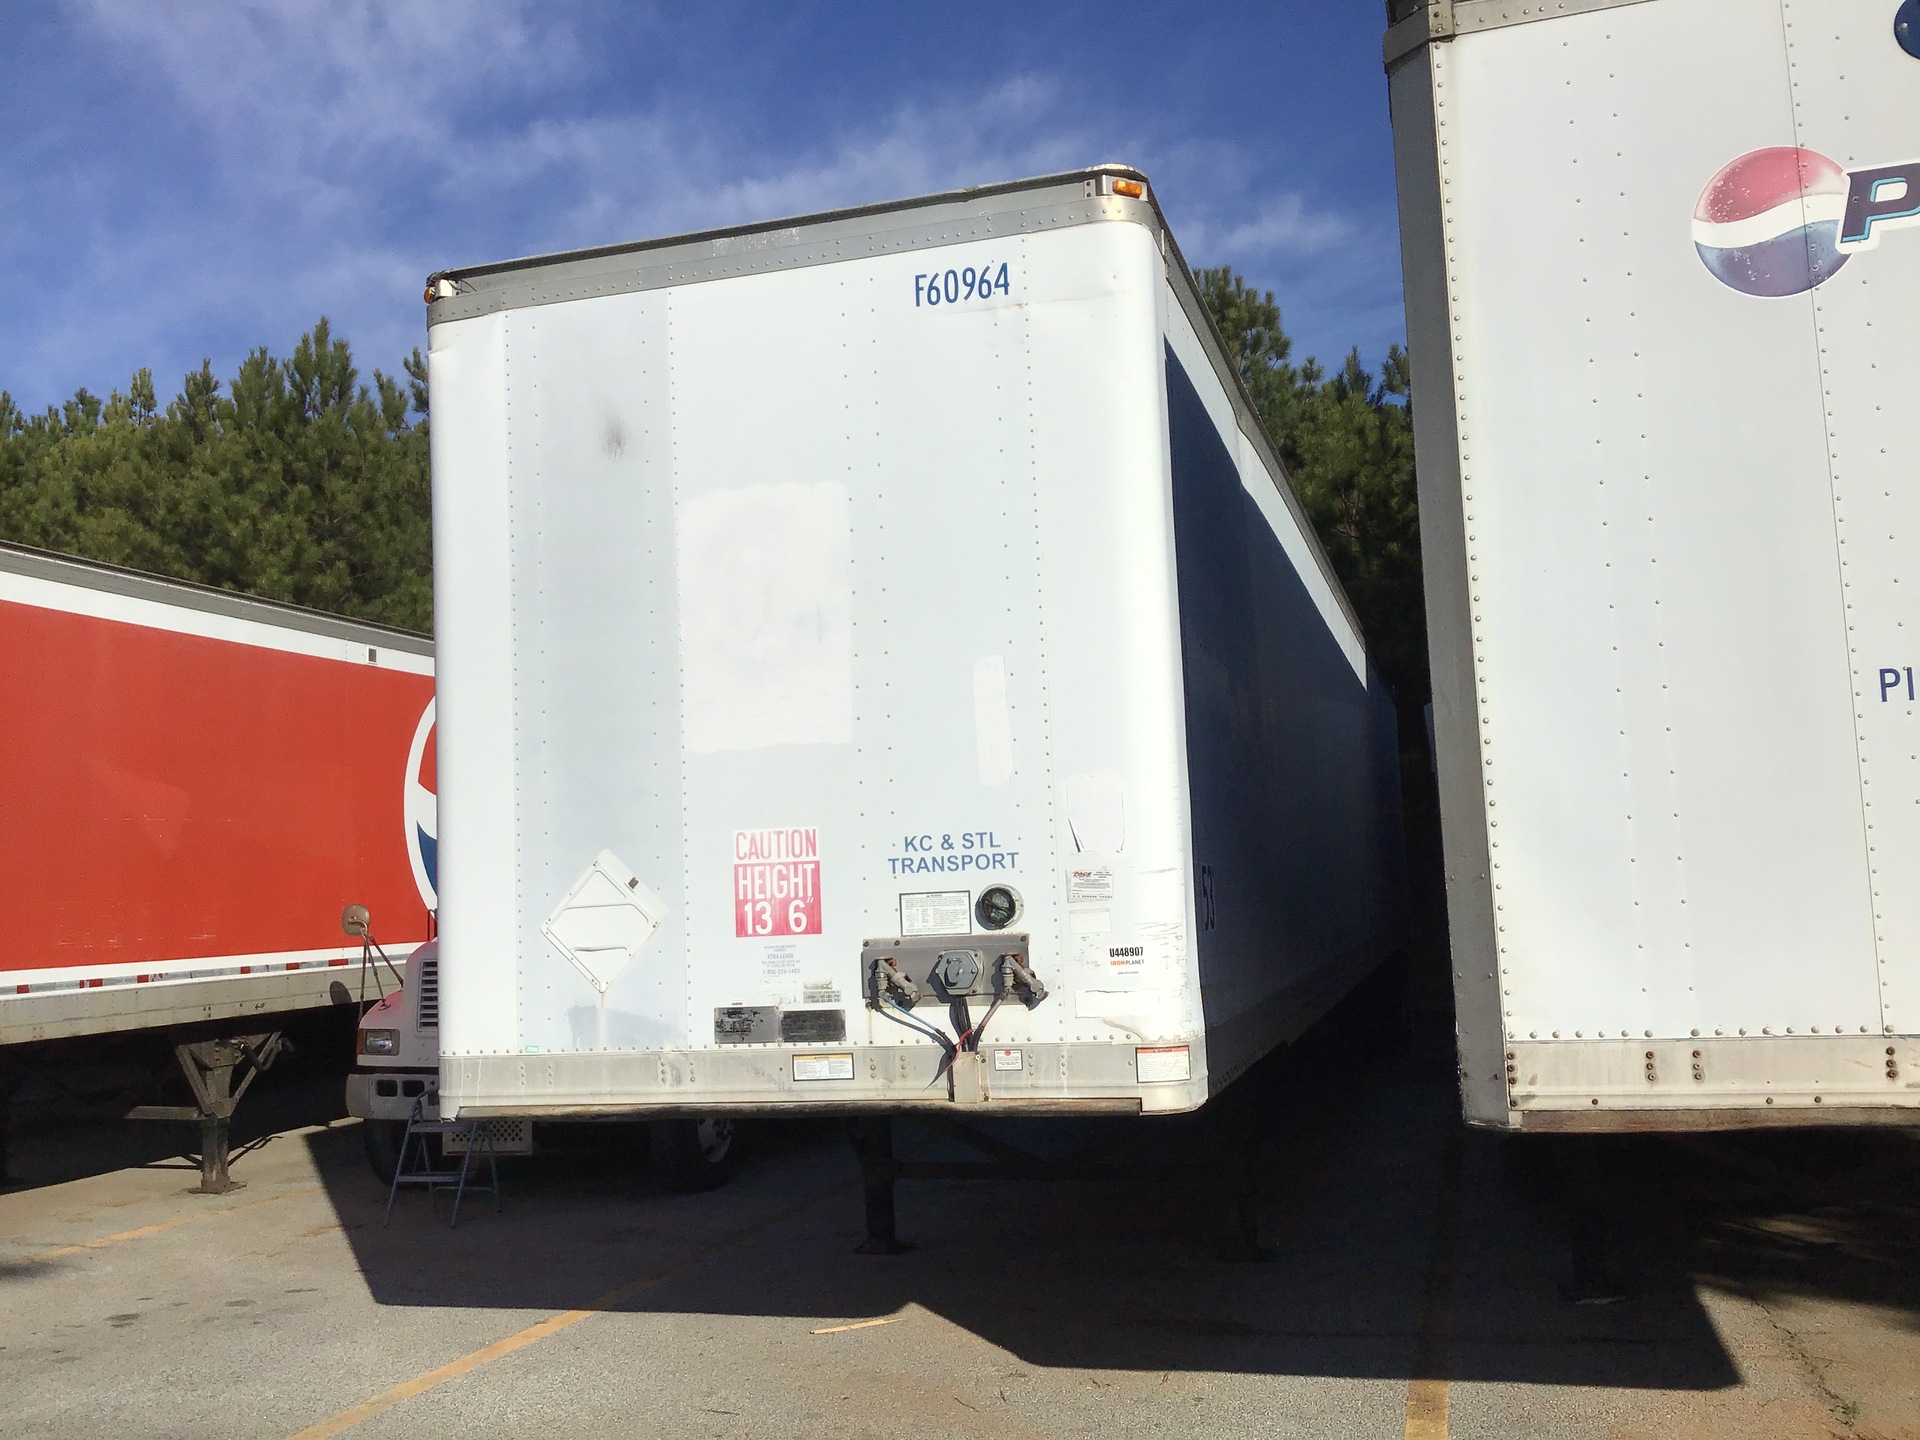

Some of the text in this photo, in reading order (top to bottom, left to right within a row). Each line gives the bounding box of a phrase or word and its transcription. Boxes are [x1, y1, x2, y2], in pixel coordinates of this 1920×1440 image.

[915, 262, 1010, 307] F60964
[735, 828, 817, 860] CAUTION
[904, 832, 1001, 852] KC & STL
[887, 852, 1019, 874] TRANSPORT
[738, 863, 816, 900] HEIGHT
[1109, 946, 1144, 958] U448907
